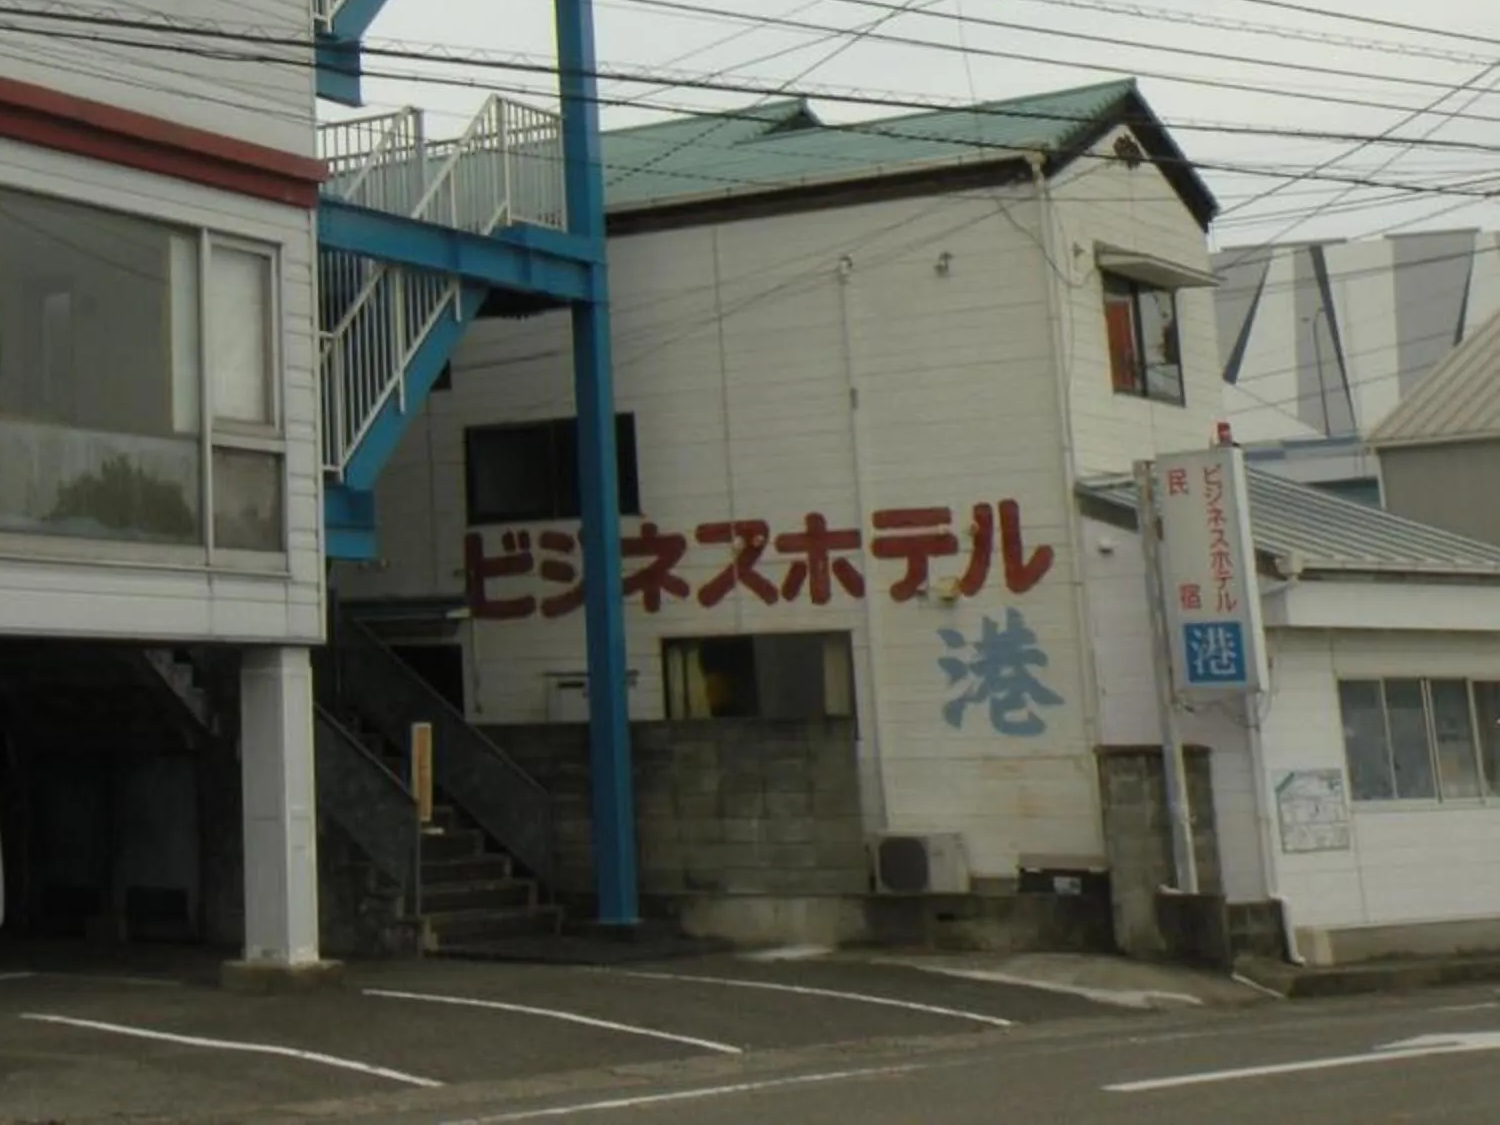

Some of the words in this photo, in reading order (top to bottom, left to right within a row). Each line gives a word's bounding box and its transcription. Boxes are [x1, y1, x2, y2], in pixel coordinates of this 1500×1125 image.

[1168, 469, 1202, 610] 民宿
[1204, 464, 1237, 612] ビジネスホテル
[936, 607, 1065, 736] 港
[1190, 626, 1237, 676] 港
